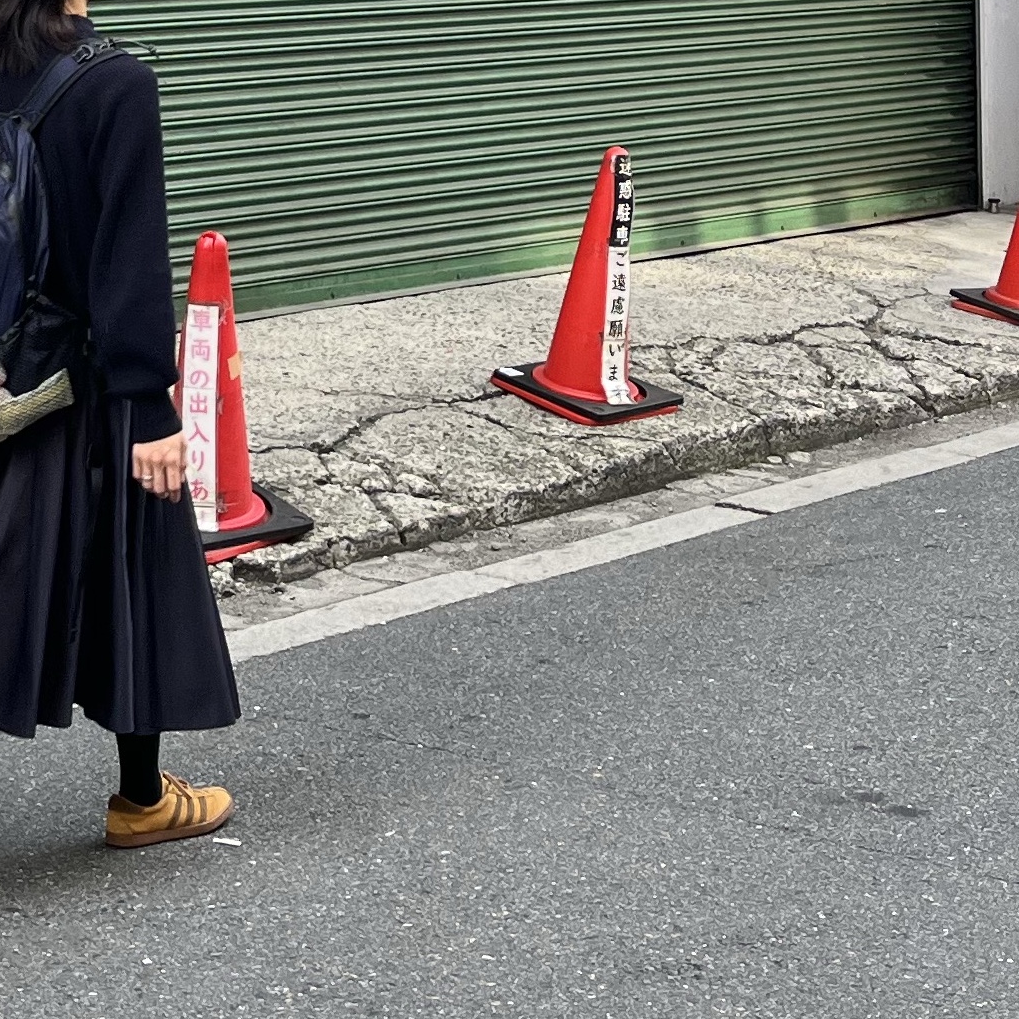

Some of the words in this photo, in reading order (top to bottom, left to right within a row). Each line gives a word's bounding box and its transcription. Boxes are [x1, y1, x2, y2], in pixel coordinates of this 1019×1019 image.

[188, 309, 213, 519] 車両の出入りあ
